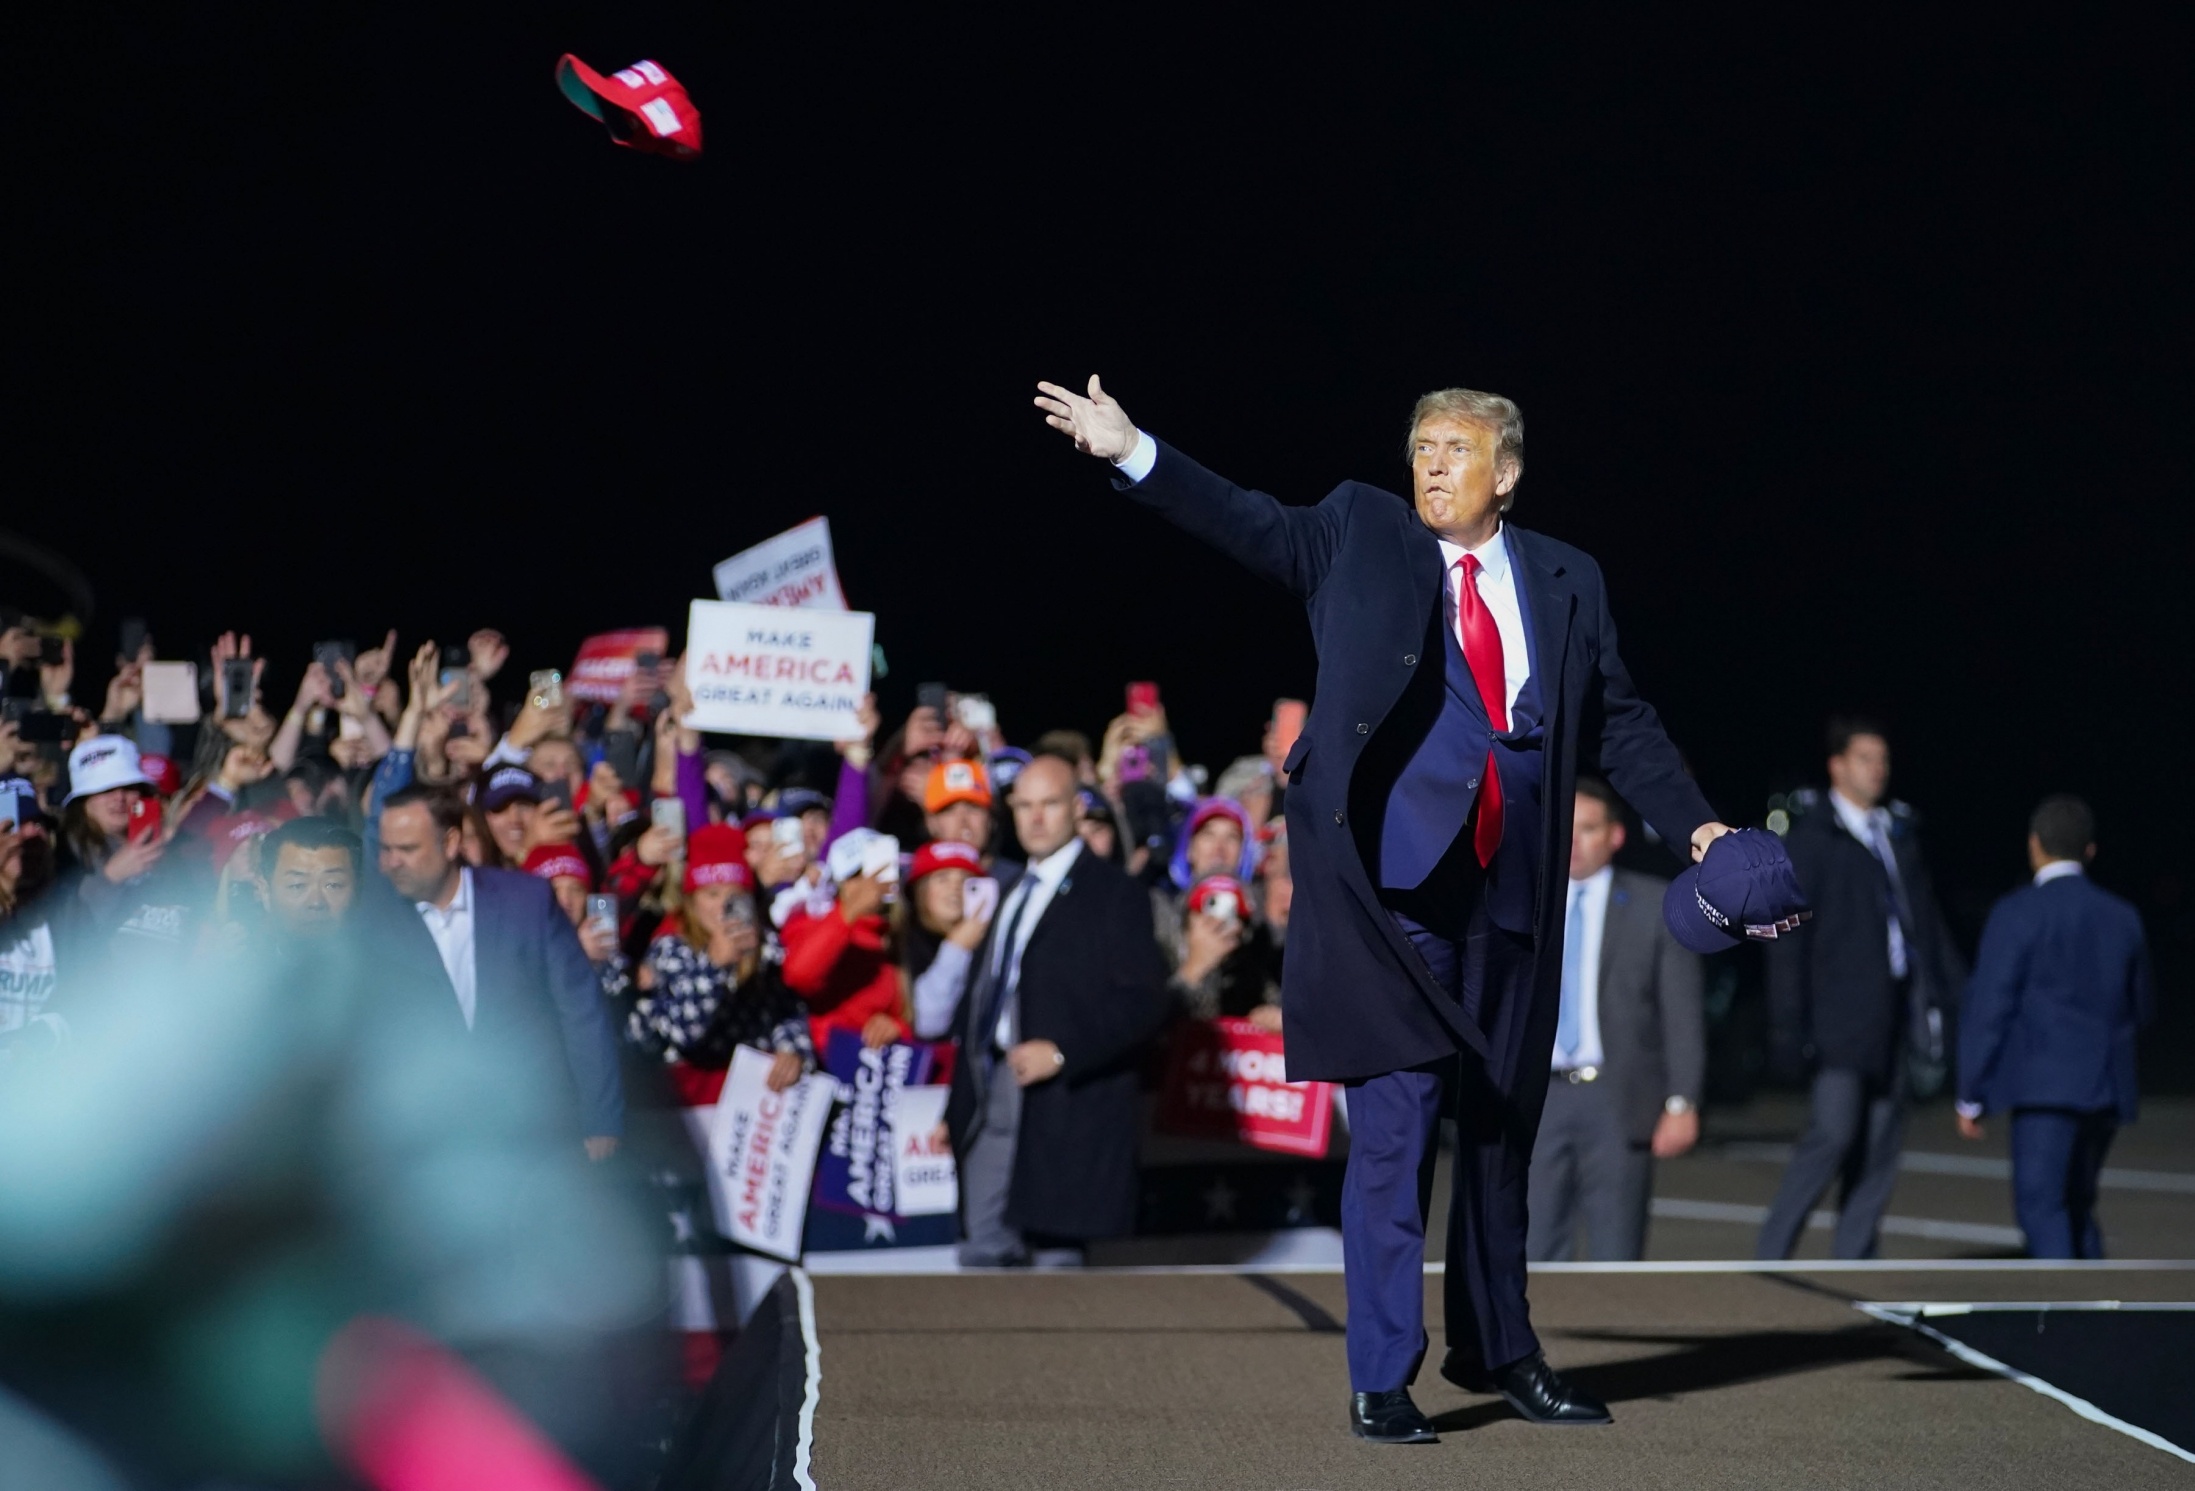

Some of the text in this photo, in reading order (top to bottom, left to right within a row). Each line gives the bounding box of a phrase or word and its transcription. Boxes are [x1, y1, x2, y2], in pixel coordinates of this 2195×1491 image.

[747, 629, 813, 648] MAKE
[701, 653, 857, 685] AMERICA
[694, 683, 857, 712] GREAT AGAIN
[0, 970, 54, 995] RUMP
[726, 1110, 749, 1177] MAKE
[738, 1092, 784, 1232] AMERIC
[763, 1162, 788, 1240] GREAT
